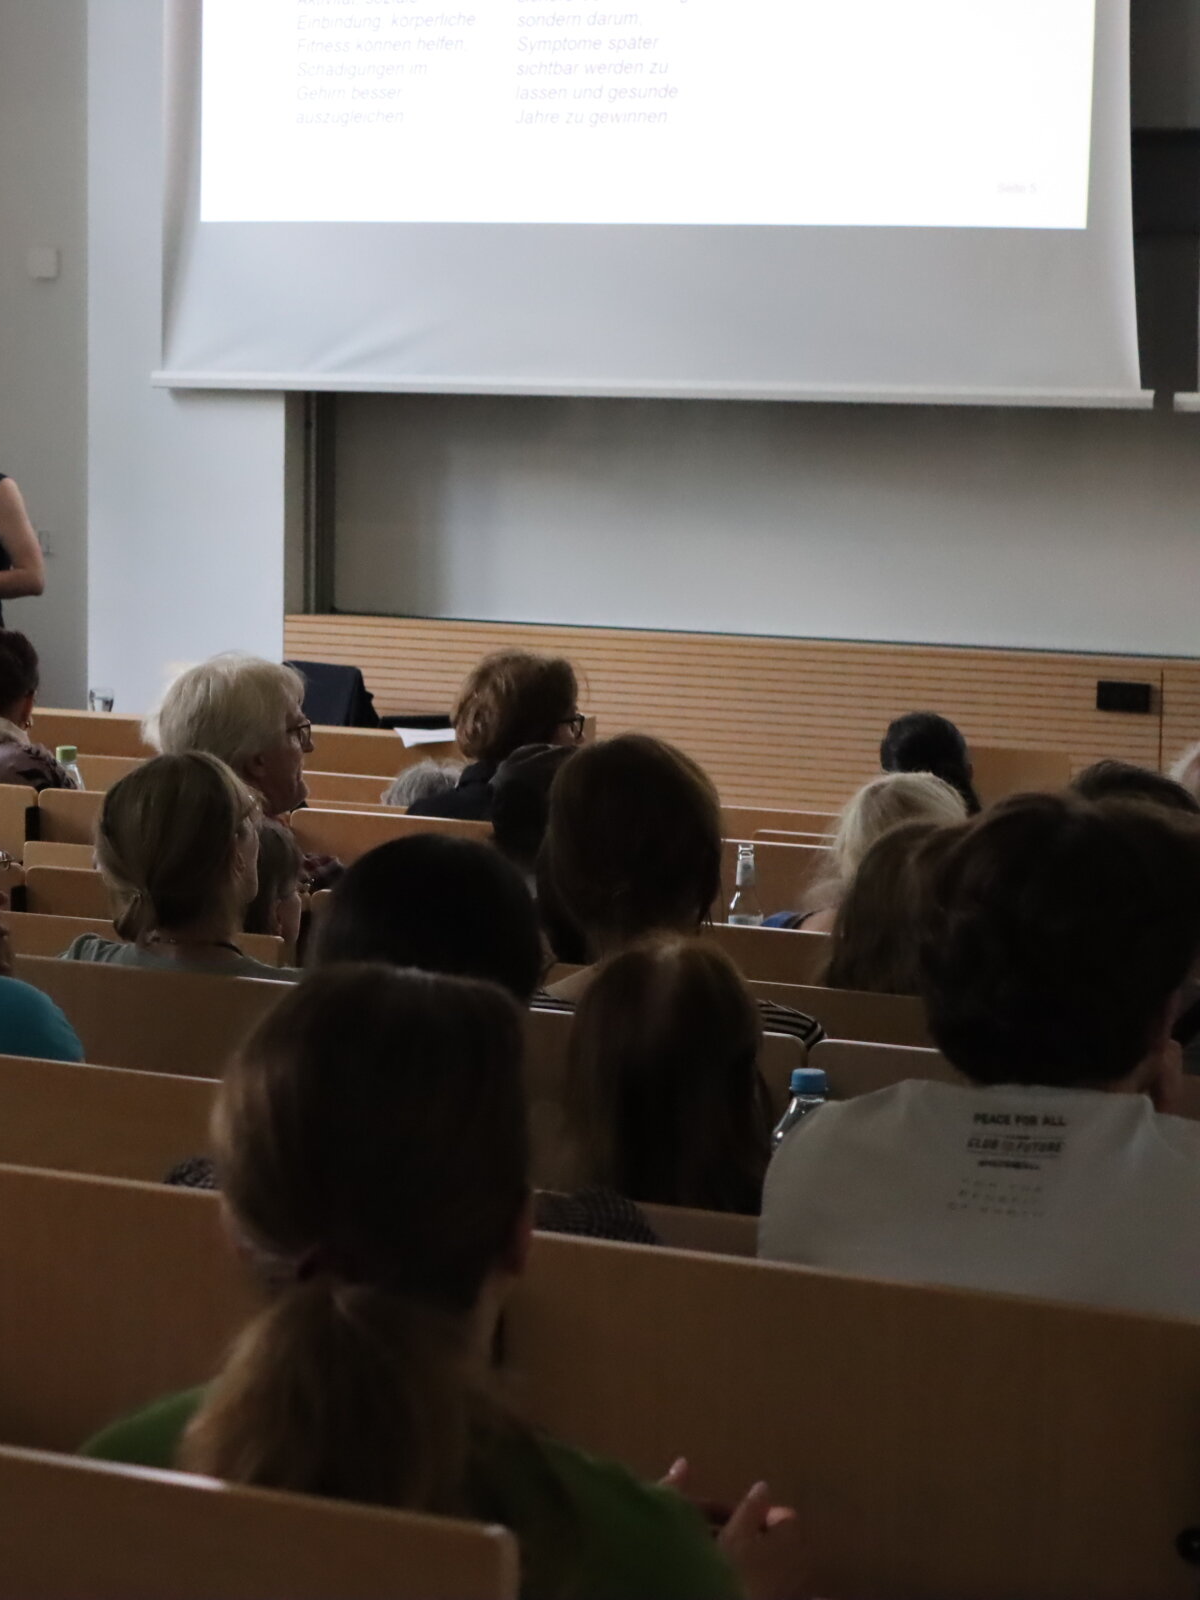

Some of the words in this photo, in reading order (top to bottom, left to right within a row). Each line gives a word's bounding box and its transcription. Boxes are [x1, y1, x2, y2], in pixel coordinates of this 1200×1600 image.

[517, 11, 582, 28] sondern
[296, 38, 351, 53] Fitness
[516, 35, 603, 55] Symptome
[409, 62, 428, 75] im
[516, 60, 580, 76] sichtbar
[584, 60, 644, 76] werden
[648, 61, 670, 75] zu
[351, 86, 403, 100] besser
[515, 85, 568, 100] lassen
[572, 84, 605, 100] und
[607, 83, 680, 103] gesunde
[515, 109, 560, 125] Jahre
[565, 111, 585, 125] zu
[973, 1112, 1011, 1126] PEACE
[1014, 1114, 1039, 1127] FOR
[1041, 1114, 1068, 1127] ALL
